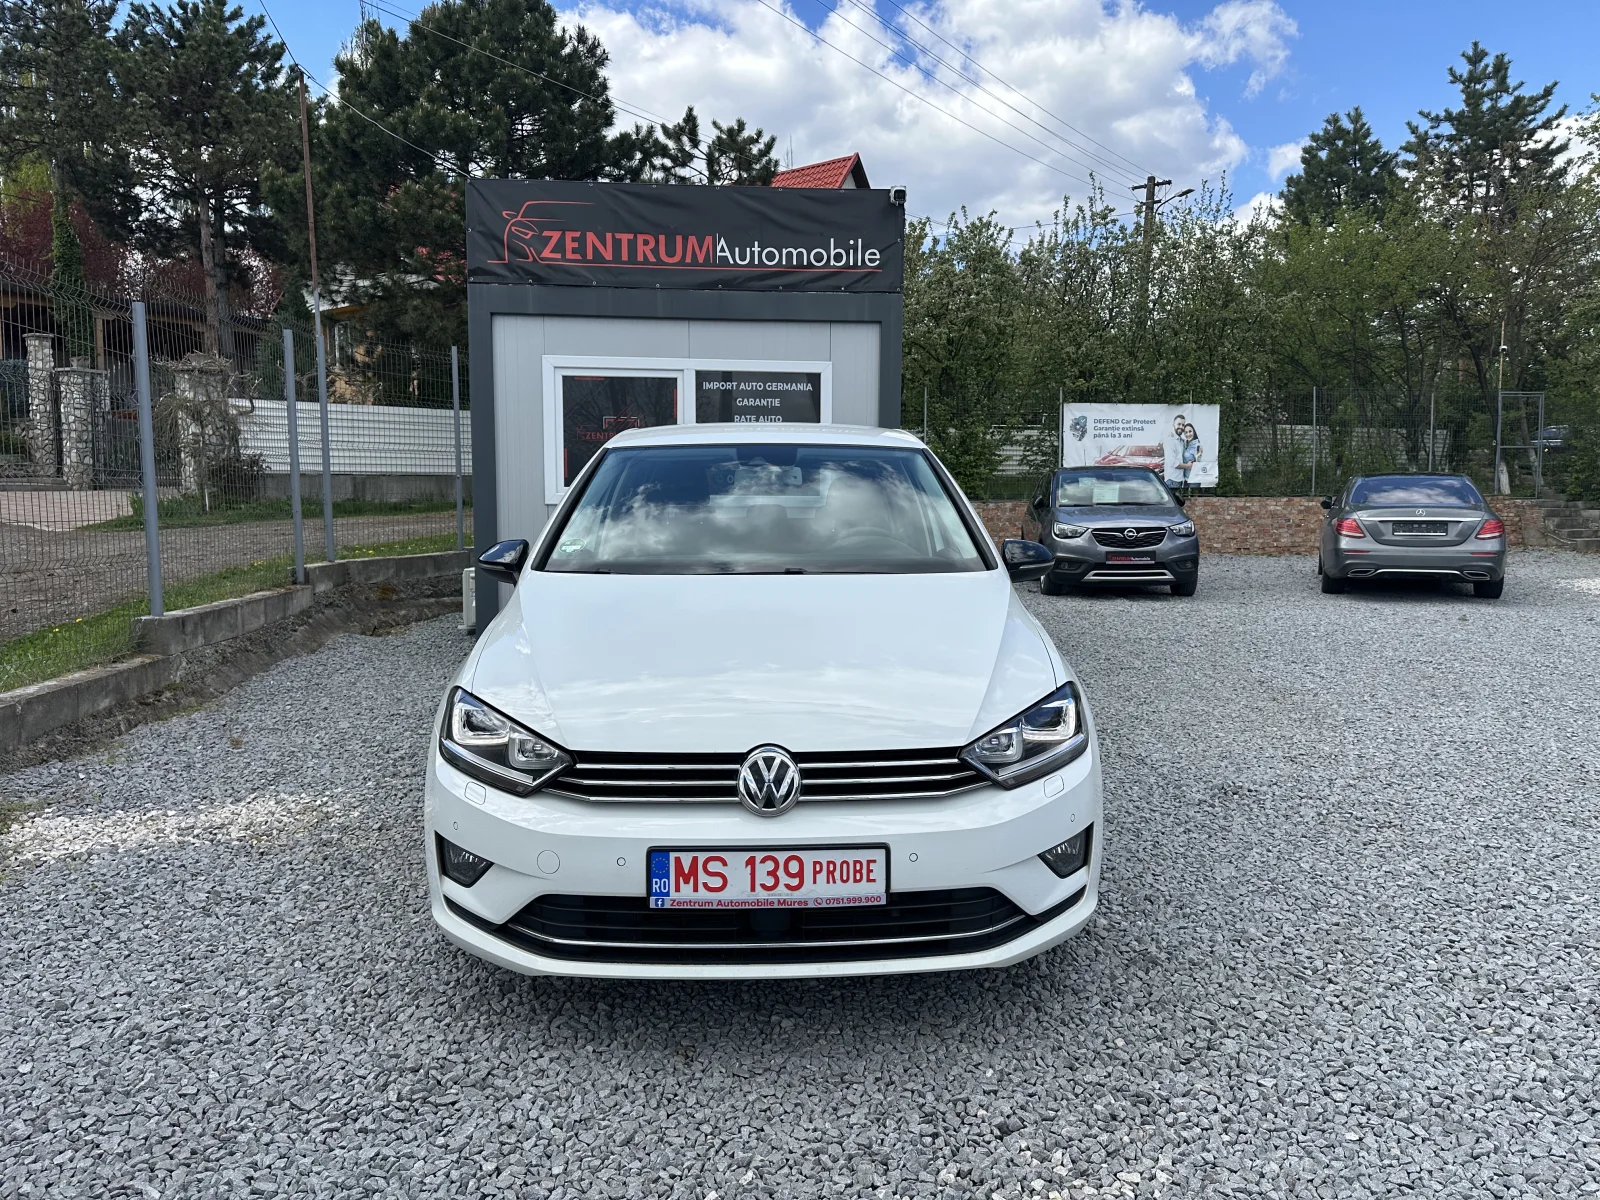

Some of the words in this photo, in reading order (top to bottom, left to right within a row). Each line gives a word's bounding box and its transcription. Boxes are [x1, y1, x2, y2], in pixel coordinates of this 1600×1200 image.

[540, 230, 713, 263] ZENTRUM
[702, 381, 738, 391] IMPORT
[739, 382, 764, 391] AUTO
[765, 382, 813, 392] GERMANIA
[736, 398, 781, 409] GARANȚIE
[734, 415, 757, 424] RATE
[758, 415, 783, 424] AUTO
[652, 878, 669, 893] RO
[673, 856, 729, 893] MS
[744, 854, 805, 893] 139
[812, 859, 877, 885] PROBE
[669, 899, 714, 907] Zentrum
[715, 897, 776, 908] Automobile
[777, 898, 809, 907] Mures
[825, 895, 882, 905] 0751.999.900
